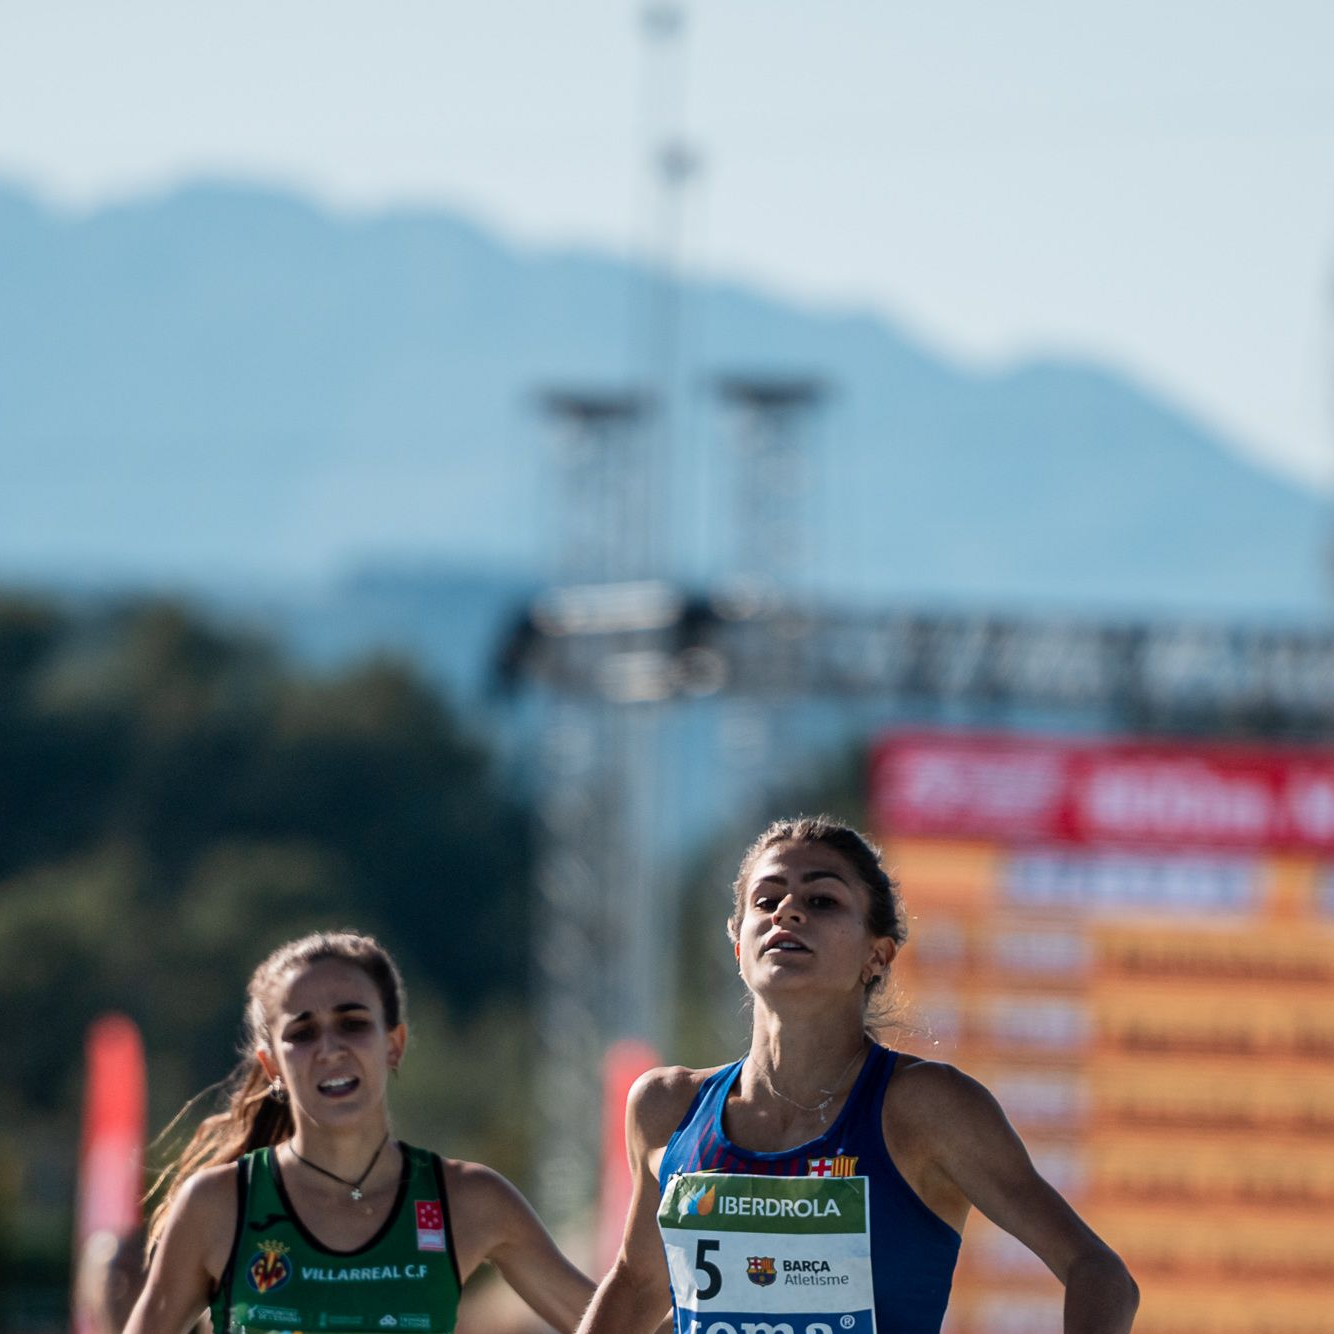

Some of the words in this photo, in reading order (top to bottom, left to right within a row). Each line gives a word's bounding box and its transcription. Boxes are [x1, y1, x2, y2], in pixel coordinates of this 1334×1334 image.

[718, 1196, 842, 1218] IBERDROLA
[301, 1265, 402, 1281] VILLARREAL
[695, 1239, 723, 1301] 5
[783, 1260, 831, 1274] BARÇA
[784, 1272, 850, 1286] Atletisme
